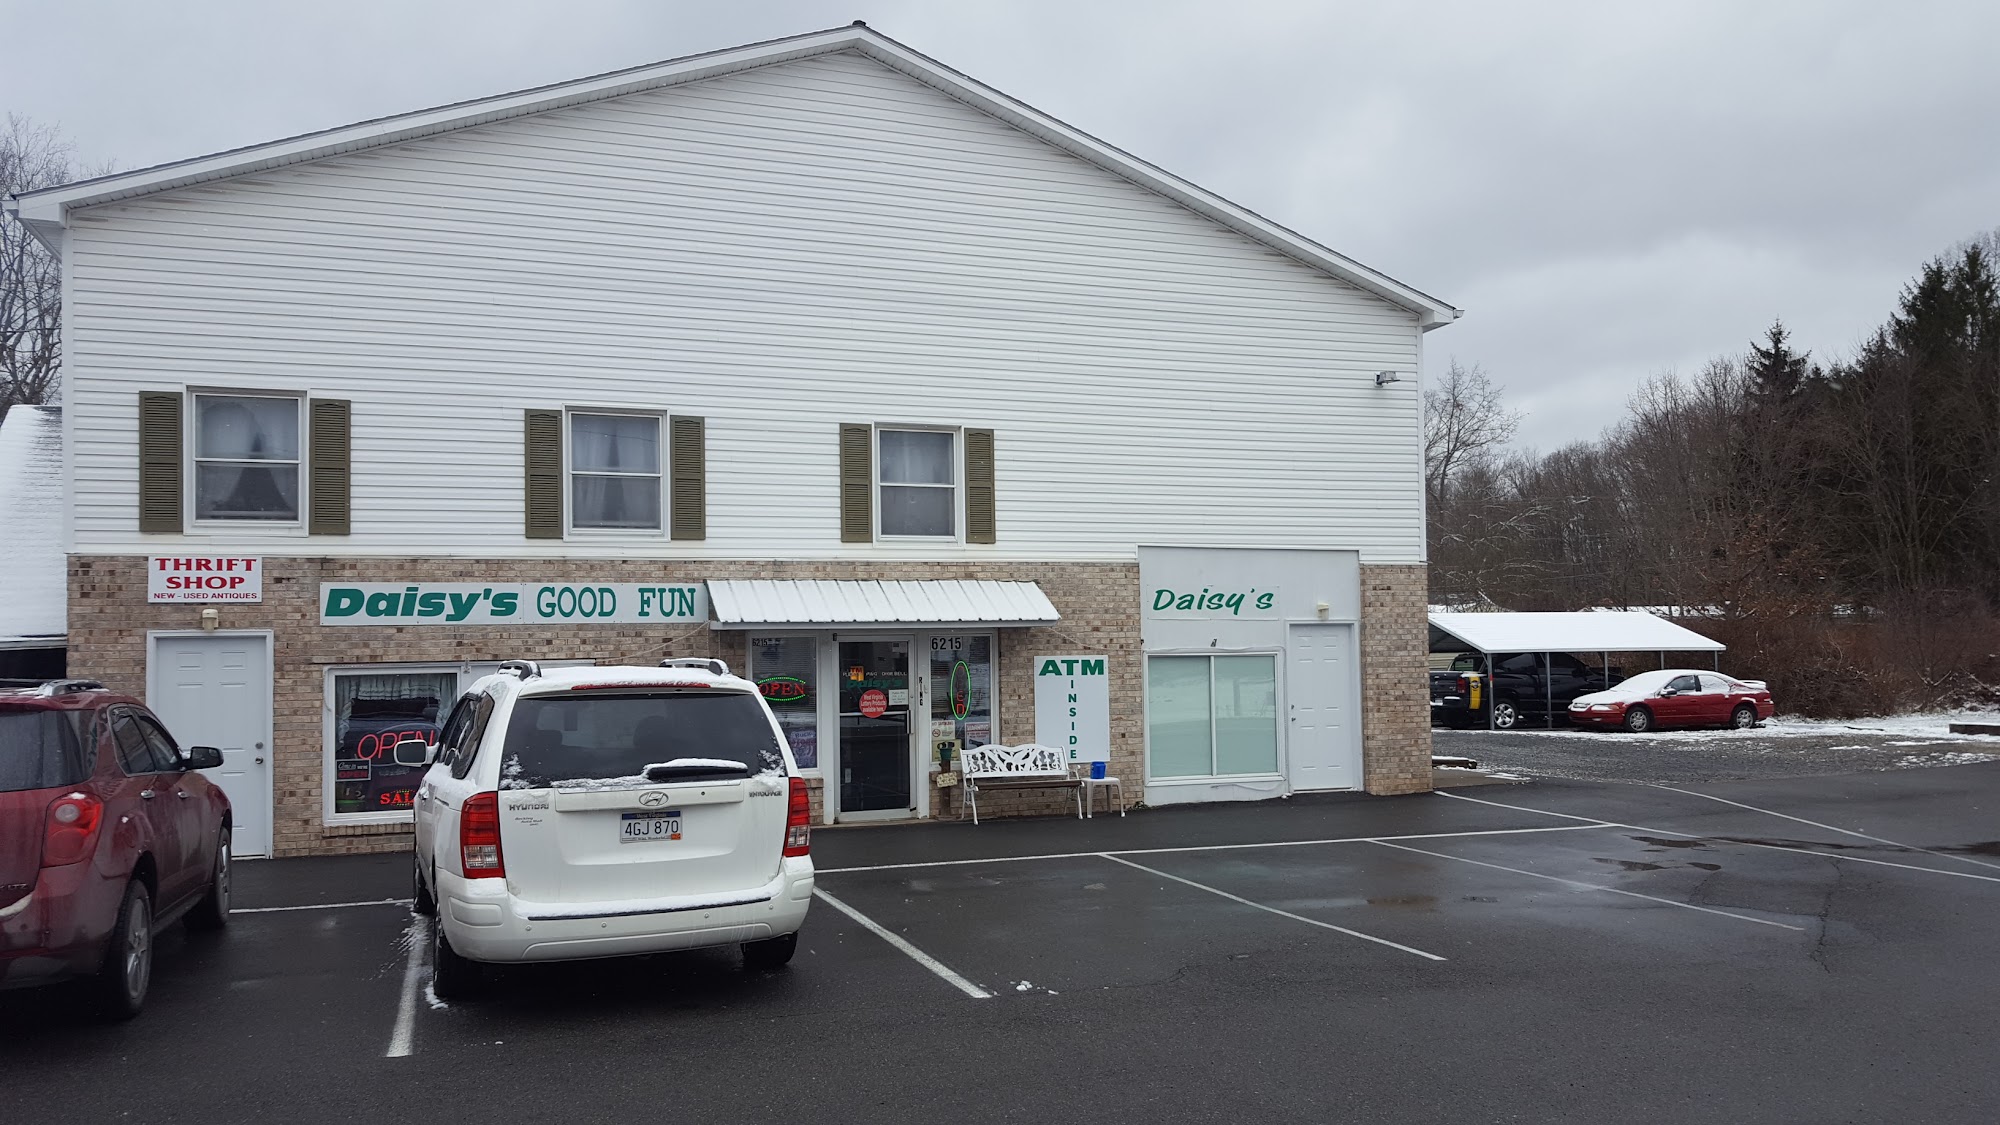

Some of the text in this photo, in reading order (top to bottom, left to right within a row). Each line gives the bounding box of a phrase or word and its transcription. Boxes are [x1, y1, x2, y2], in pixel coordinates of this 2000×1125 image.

[154, 558, 257, 571] THRIFT
[166, 576, 245, 589] SHOP
[324, 587, 696, 622] Daisy's GOOD FUN
[1152, 588, 1274, 615] Daisy's
[752, 638, 768, 647] 6215
[931, 637, 962, 650] 6215
[1039, 659, 1105, 676] ATM
[758, 682, 805, 696] OPEN
[1068, 679, 1078, 759] INSIDE
[509, 803, 549, 811] HYUNDAI
[624, 820, 679, 836] 4GJ 870
